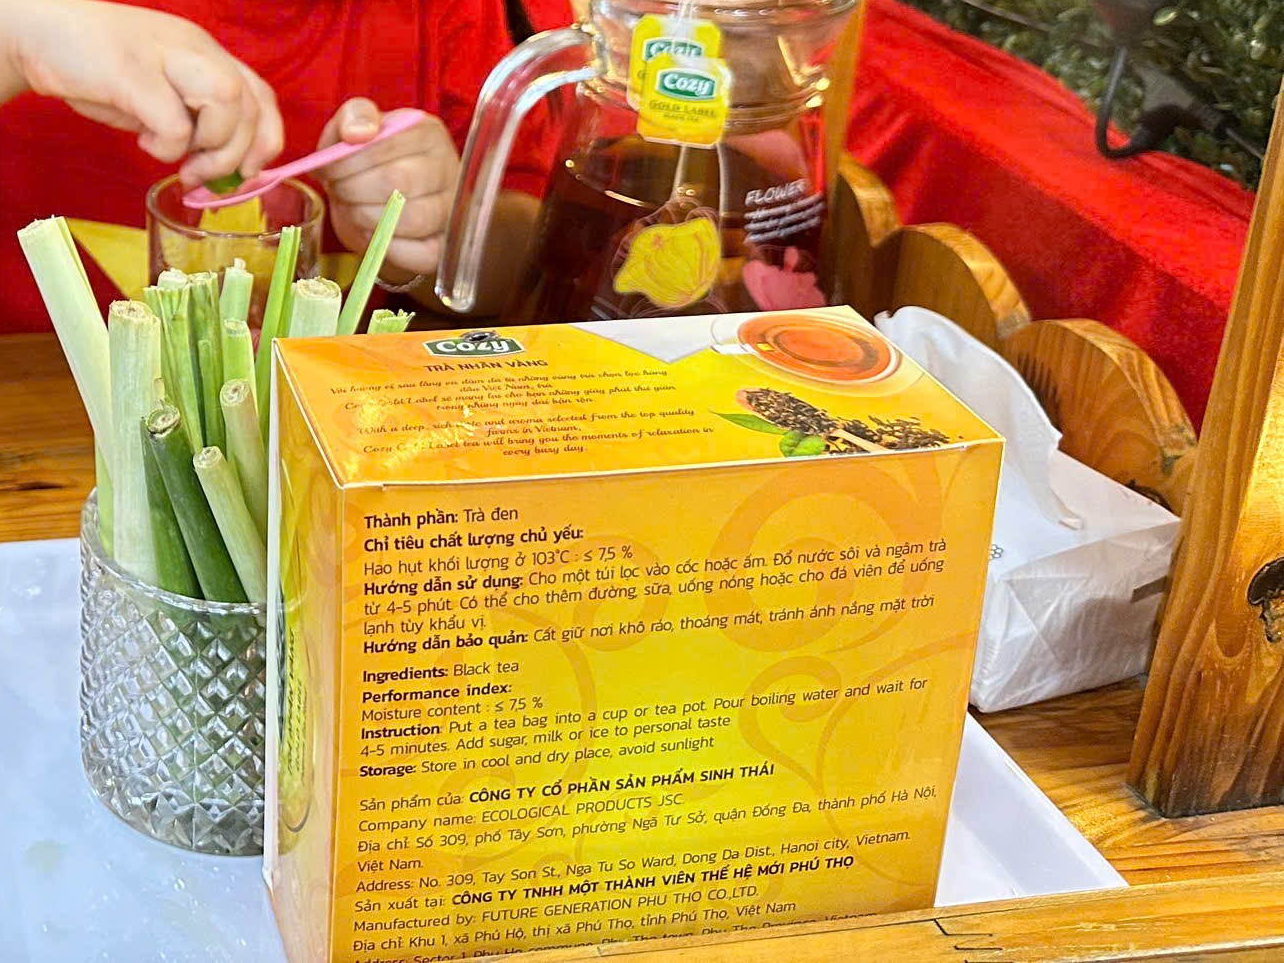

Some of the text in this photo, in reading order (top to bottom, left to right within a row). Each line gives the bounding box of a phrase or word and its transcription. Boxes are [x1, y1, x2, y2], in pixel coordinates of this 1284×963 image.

[663, 72, 713, 96] Cozy
[744, 179, 807, 206] FLOWER
[435, 339, 511, 352] Cozy
[363, 505, 518, 530] Thành phần: Trà đen
[363, 522, 584, 552] Chỉ tiêu chất lượng chủ yếu:
[363, 561, 393, 576] Hao
[397, 559, 423, 577] hụt
[427, 554, 460, 572] khối
[465, 555, 509, 572] lượng
[514, 550, 527, 567] ở
[620, 544, 633, 559] %
[363, 578, 419, 596] Hướng
[422, 574, 452, 592] dẫn
[455, 573, 478, 591] sử
[481, 573, 524, 592] dụng:
[527, 570, 557, 586] Cho
[561, 567, 590, 585] một
[594, 565, 615, 581] túi
[619, 564, 640, 581] lọc
[644, 561, 671, 577] vào
[674, 557, 699, 574] cốc
[703, 556, 738, 573] hoặc
[772, 548, 793, 566] Đổ
[796, 547, 835, 564] nước
[838, 545, 859, 561] sôi
[864, 543, 881, 558] và
[885, 541, 924, 559] ngâm
[928, 537, 946, 552] trà
[363, 619, 395, 638] lạnh
[399, 617, 424, 635] tùy
[428, 613, 465, 631] khẩu
[362, 661, 519, 685] Ingredients: Black tea
[361, 681, 512, 704] Performance index:
[448, 720, 473, 734] Put
[477, 720, 487, 731] a
[492, 717, 516, 730] tea
[521, 714, 548, 729] bag
[554, 711, 582, 724] into
[586, 711, 596, 722] a
[601, 708, 628, 723] cup
[632, 706, 649, 718] or
[654, 703, 677, 716] tea
[712, 697, 746, 710] Pour
[750, 691, 796, 707] boiling
[801, 688, 840, 702] water
[843, 682, 871, 698] and
[875, 679, 904, 694] wait
[909, 676, 928, 690] for
[389, 740, 450, 755] minutes.
[454, 735, 484, 751] Add
[488, 734, 528, 749] sugar,
[532, 728, 563, 744] milk
[567, 729, 584, 741] or
[588, 725, 609, 739] ice
[613, 724, 629, 737] to
[632, 716, 692, 739] personal
[696, 715, 731, 729] taste
[358, 735, 714, 778] Storage: Store in cool and dry place, avoid sunlight
[359, 796, 386, 812] Sản
[390, 793, 431, 813] phẩm
[468, 786, 511, 803] CÔNG
[515, 785, 537, 799] TY
[540, 778, 563, 797] CỔ
[566, 775, 611, 795] PHẦN
[614, 772, 647, 790] SẢN
[650, 766, 695, 787] PHẨM
[698, 766, 735, 782] SINH
[738, 759, 775, 778] THÁI
[357, 792, 686, 833] Company name: ECOLOGICAL PRODUCTS JSC.
[354, 898, 381, 913] Sản
[386, 895, 418, 910] xuất
[450, 889, 493, 906] CÔNG
[496, 887, 518, 902] TY
[521, 884, 564, 899] TNHH
[567, 878, 600, 896] MỘT
[603, 874, 656, 894] THÀNH
[660, 869, 696, 886] VIÊN
[699, 863, 730, 882] THẾ
[731, 862, 754, 881] HỆ
[756, 859, 785, 877] MỚI
[788, 855, 820, 873] PHÚ
[823, 854, 854, 869] THỌ
[353, 913, 450, 932] Manufactured
[454, 912, 476, 927] by:
[481, 905, 539, 923] FUTURE
[543, 896, 633, 917] GENERATION
[636, 893, 668, 908] PHU
[672, 890, 702, 904] THO
